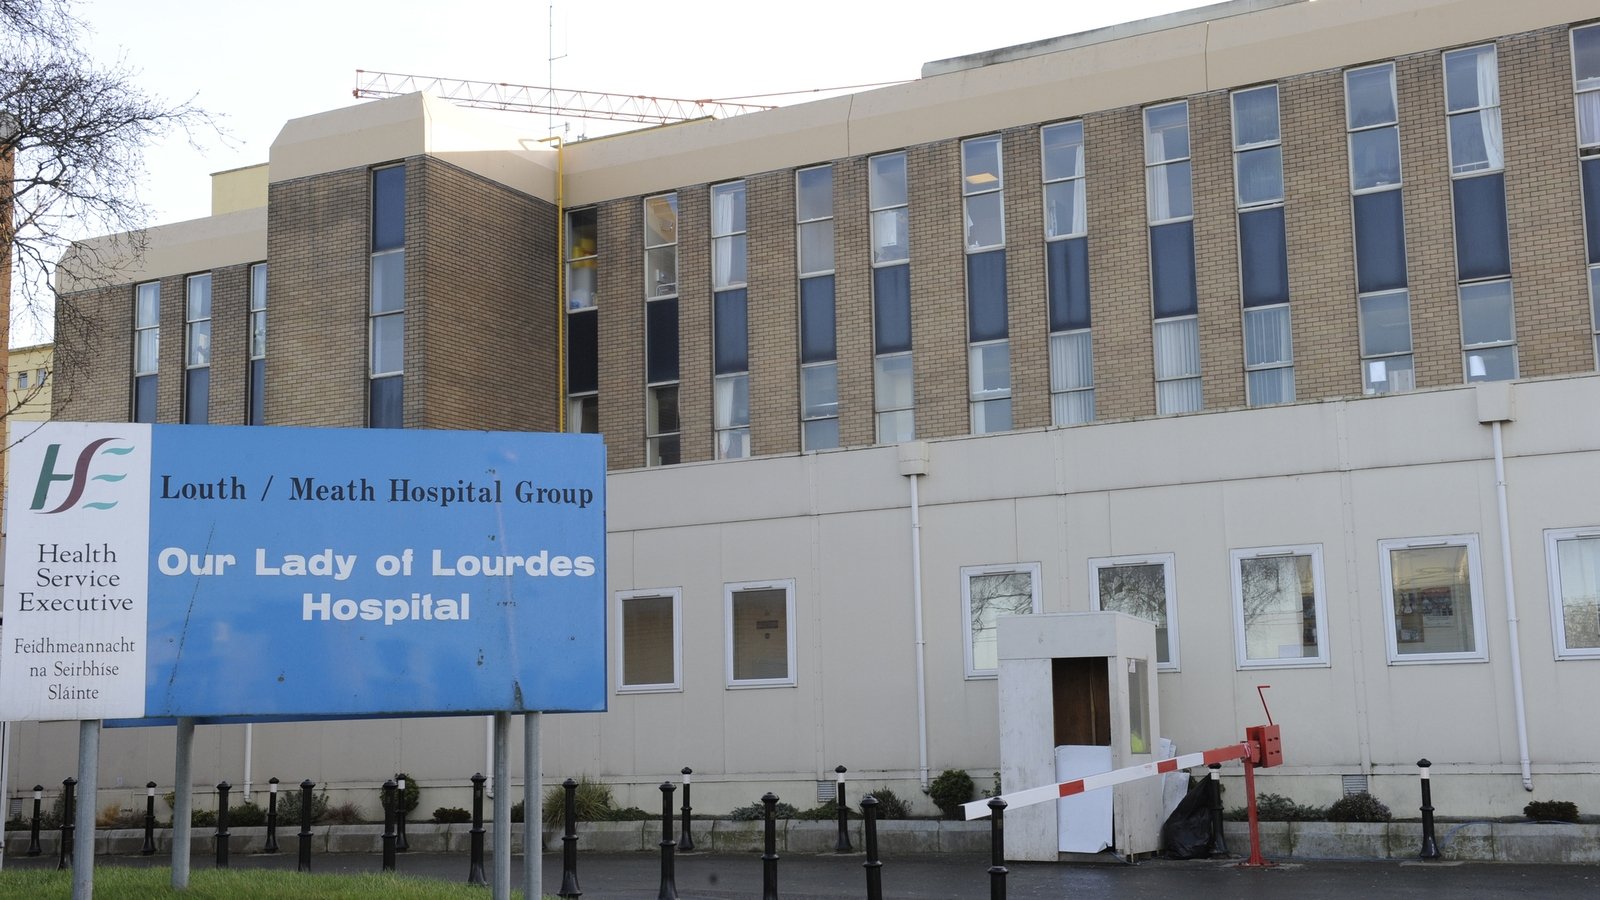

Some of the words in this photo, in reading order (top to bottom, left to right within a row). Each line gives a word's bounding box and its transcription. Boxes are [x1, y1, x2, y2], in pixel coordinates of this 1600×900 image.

[160, 475, 247, 500] Louth
[288, 477, 375, 503] Meath
[388, 479, 502, 507] Hospital
[514, 481, 594, 508] Group
[37, 543, 118, 563] Health
[157, 547, 236, 576] Our
[255, 548, 357, 581] Lady
[376, 549, 413, 577] of
[431, 550, 596, 578] Lourdes
[36, 567, 121, 588] Service
[18, 592, 134, 612] Executive
[302, 593, 470, 626] Hospital
[14, 637, 136, 654] Feidhmeannacht
[29, 665, 47, 677] na
[54, 661, 119, 677] Seirbhíse
[48, 684, 99, 700] Sláinte
